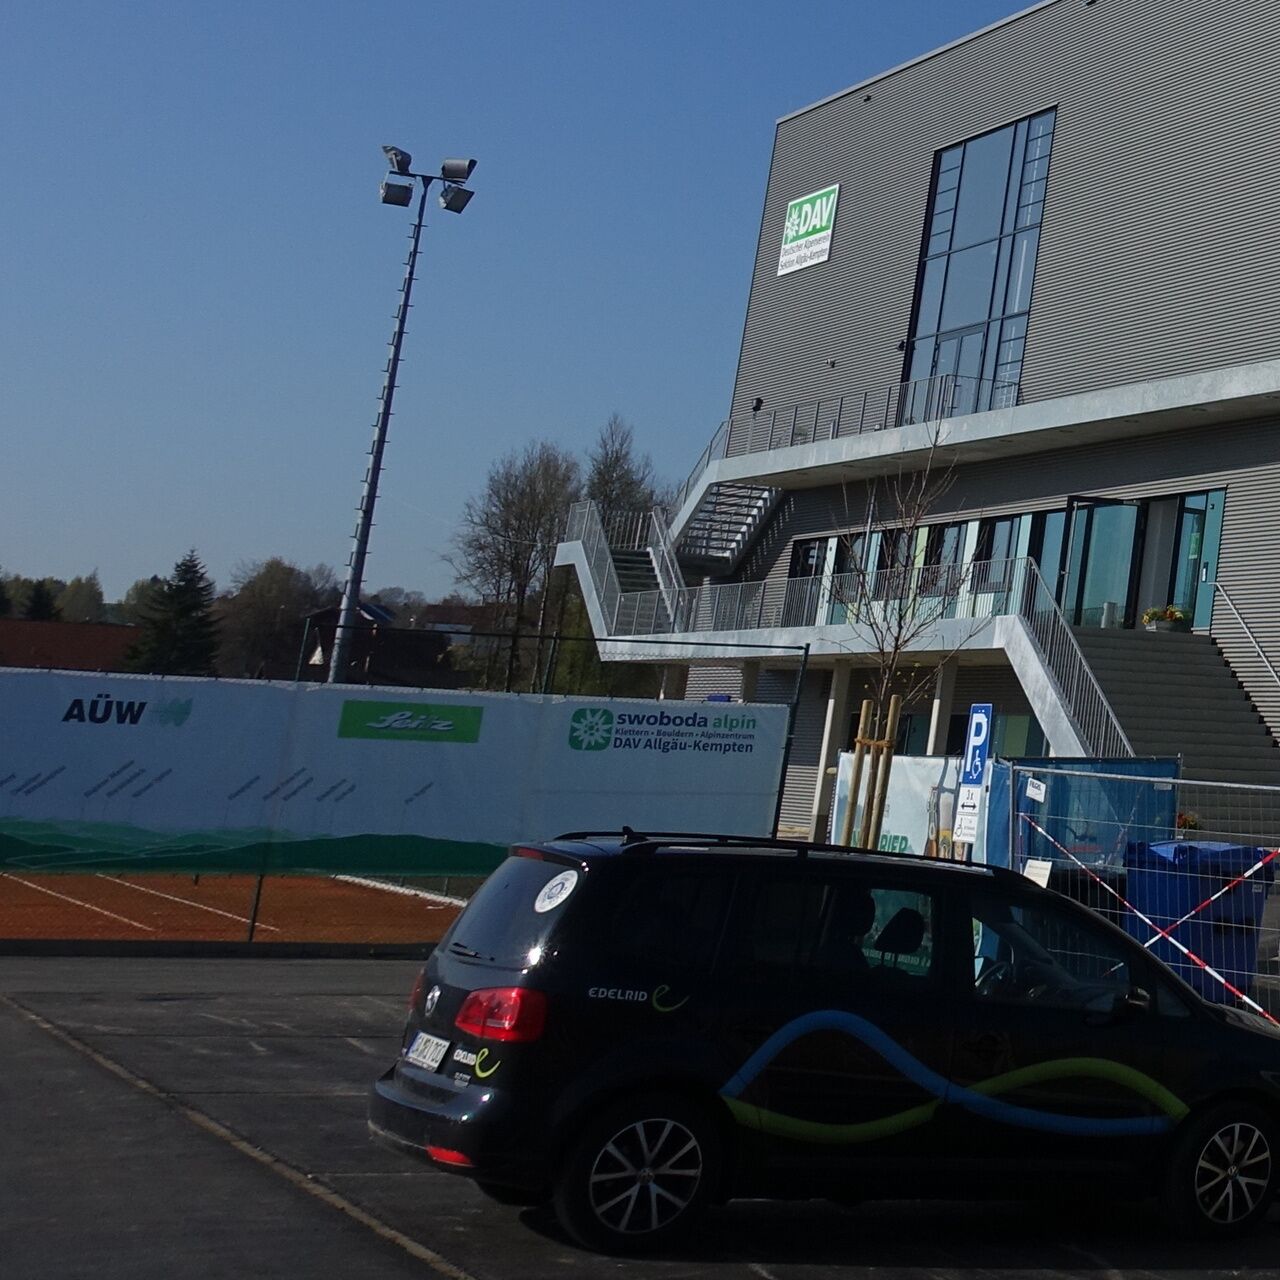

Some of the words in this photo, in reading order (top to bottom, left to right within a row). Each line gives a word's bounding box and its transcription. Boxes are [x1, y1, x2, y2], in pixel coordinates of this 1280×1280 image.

[798, 194, 835, 235] DAV
[61, 693, 149, 725] AÜW
[616, 711, 708, 728] swoboda
[712, 713, 757, 732] alpin
[614, 727, 650, 736] Klettern
[656, 728, 694, 738] Bouldern
[699, 730, 755, 740] Alpinzentrum
[965, 713, 988, 772] P
[613, 737, 641, 749] DAV
[643, 737, 754, 754] Allgäu-Kempten
[588, 987, 648, 1001] EDELRID
